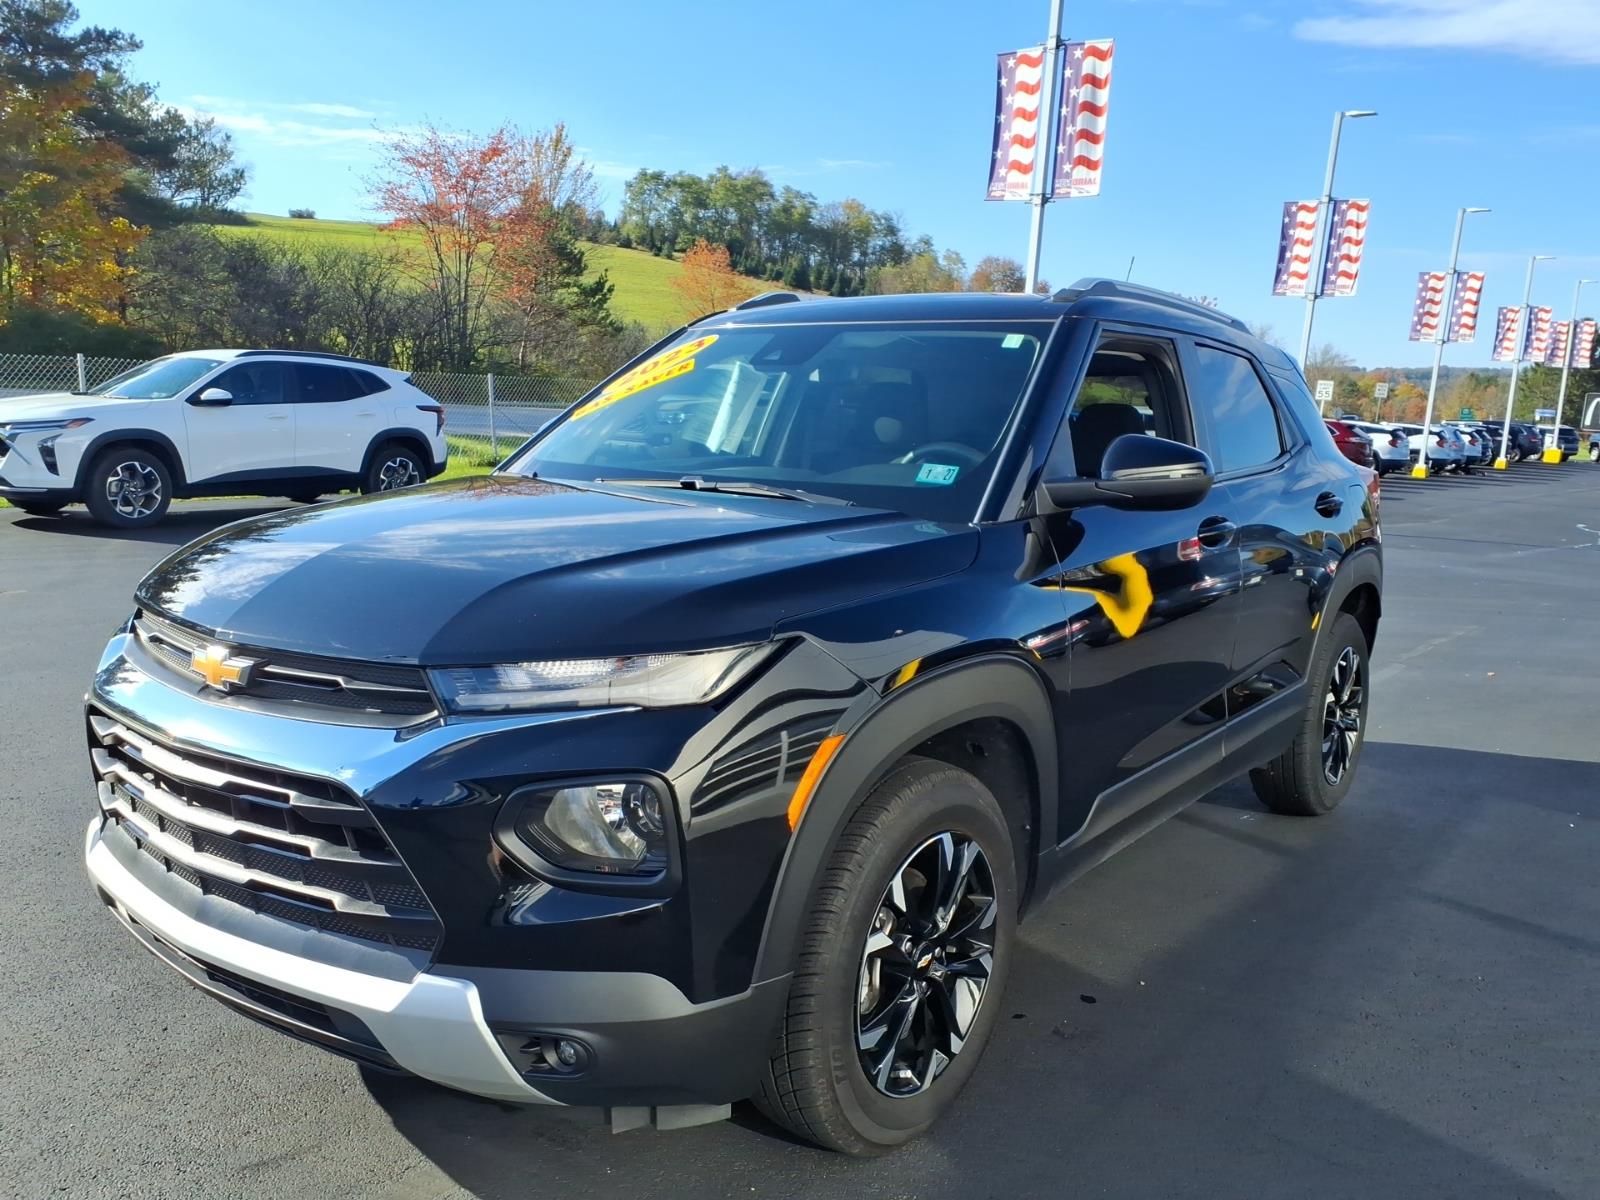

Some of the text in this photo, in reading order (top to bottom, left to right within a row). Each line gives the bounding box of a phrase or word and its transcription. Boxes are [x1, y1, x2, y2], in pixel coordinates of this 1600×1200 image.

[619, 339, 705, 386] 2023
[1318, 390, 1331, 398] 55
[943, 468, 956, 481] 27
